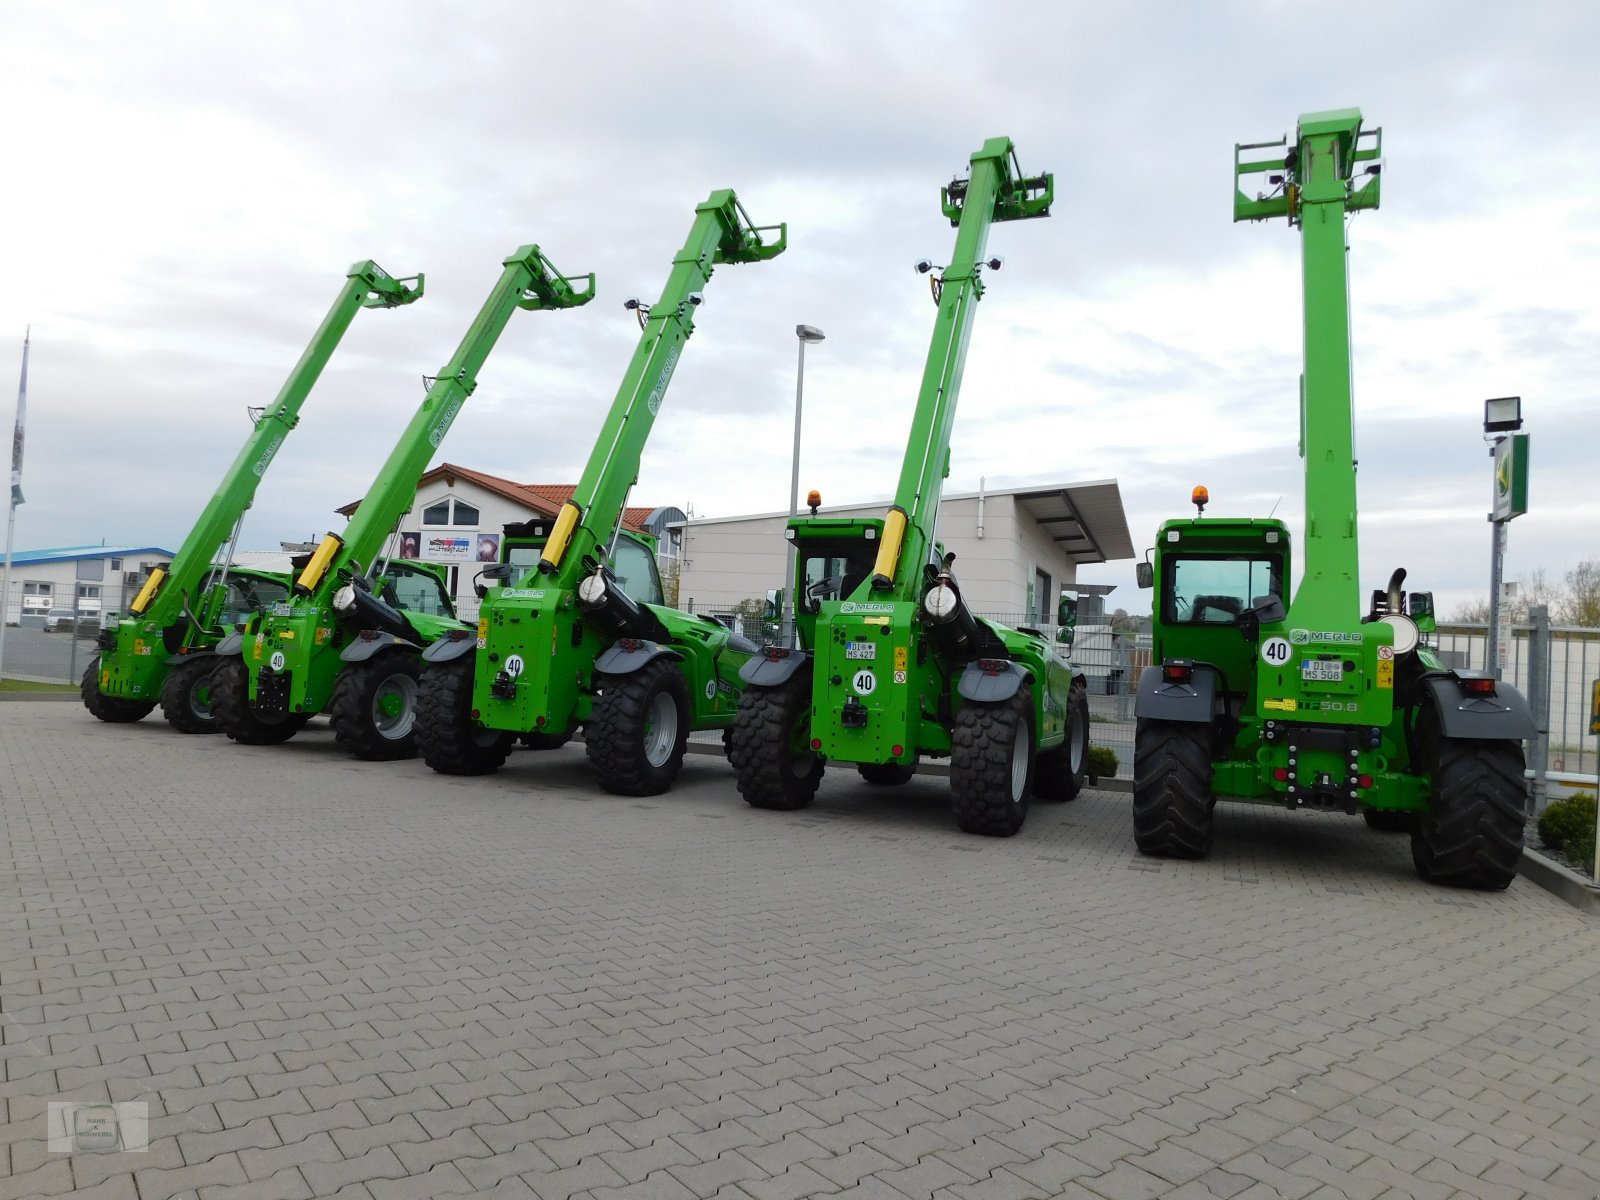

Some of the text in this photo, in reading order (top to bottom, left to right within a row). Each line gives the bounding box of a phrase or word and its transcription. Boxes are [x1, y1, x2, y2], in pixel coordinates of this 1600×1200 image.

[655, 347, 677, 393] MERLO
[438, 397, 459, 430] MERLO
[1311, 632, 1362, 641] MERLO
[852, 643, 861, 651] DI
[1266, 642, 1287, 660] 40
[272, 655, 283, 668] 40
[859, 651, 874, 659] 427
[508, 659, 521, 673] 40
[1313, 661, 1325, 671] DI
[1304, 670, 1340, 680] MS 508
[857, 675, 872, 691] 40
